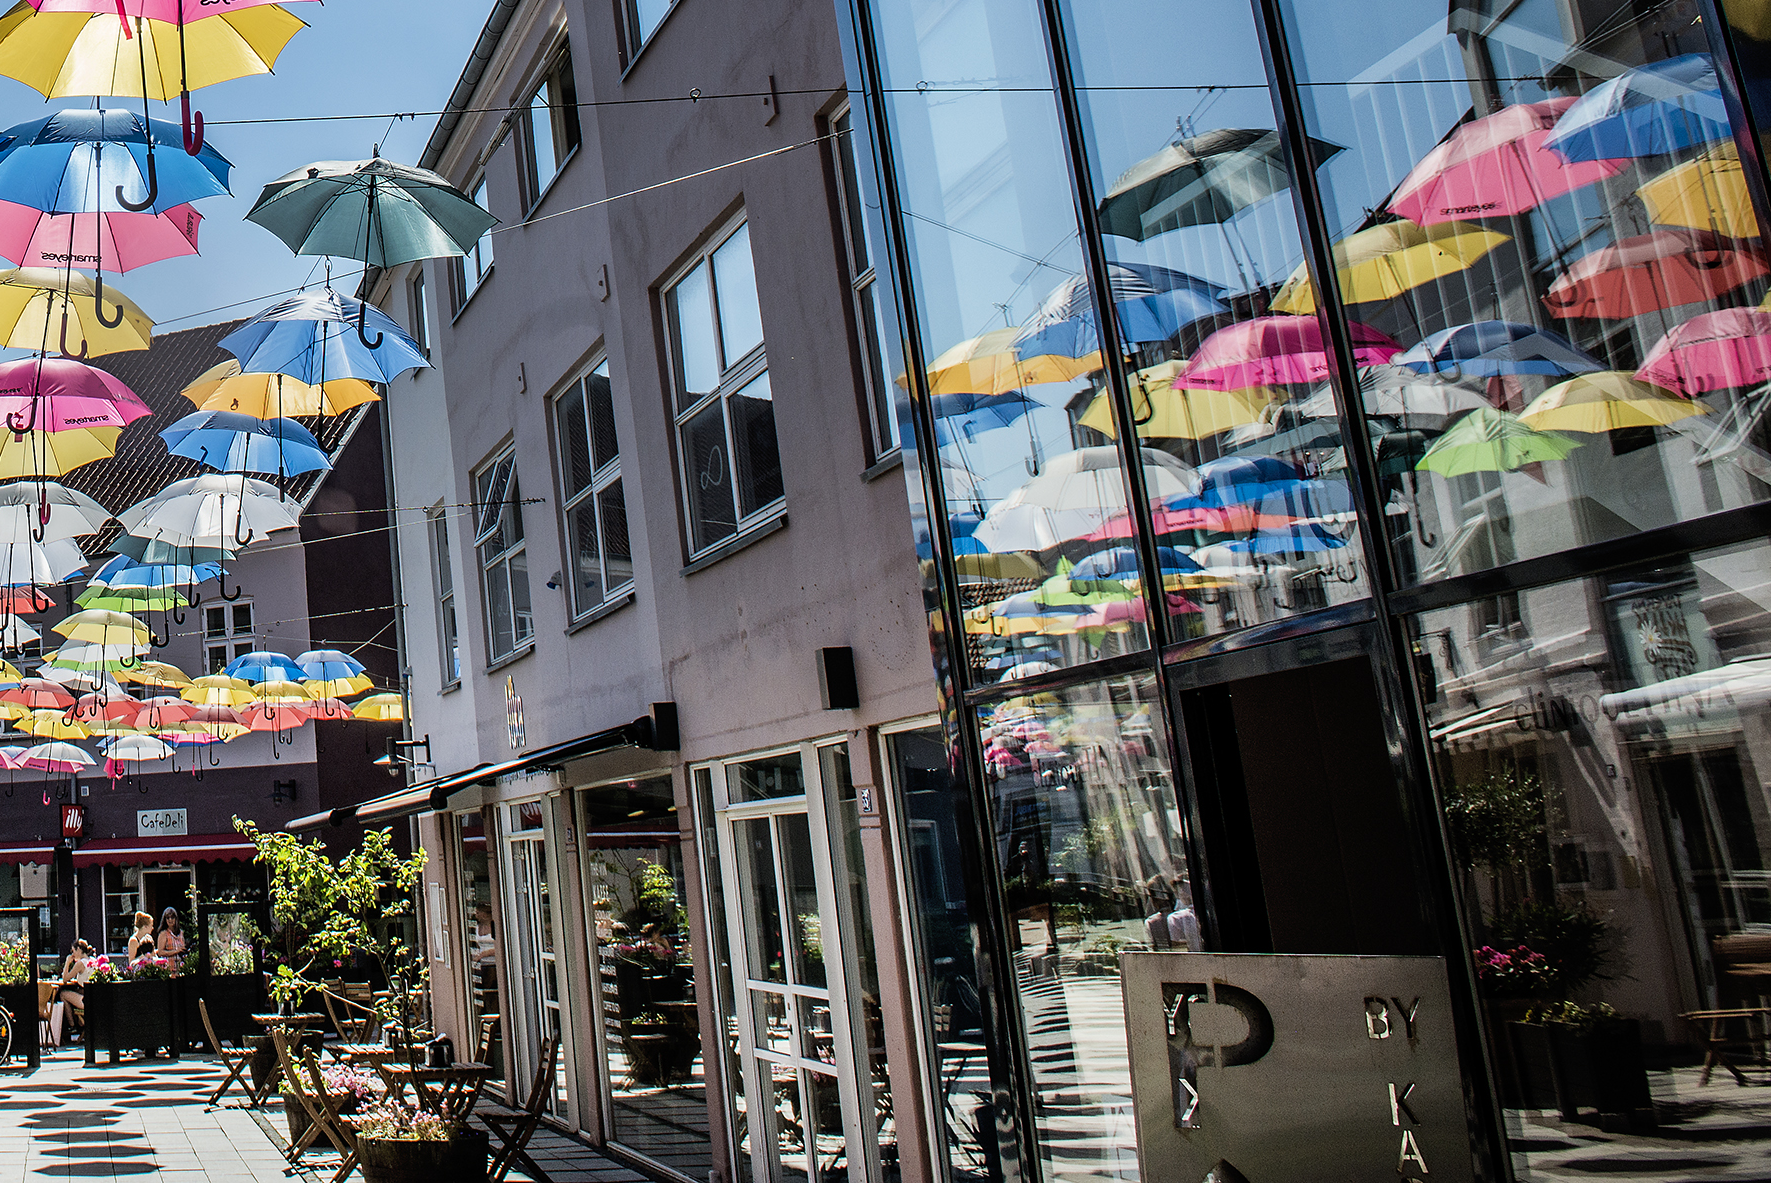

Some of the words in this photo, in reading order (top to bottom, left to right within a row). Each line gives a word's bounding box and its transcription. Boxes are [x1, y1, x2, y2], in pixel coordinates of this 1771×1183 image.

[65, 808, 82, 833] illy
[140, 812, 185, 831] CafeDeli
[1364, 997, 1421, 1039] BY
